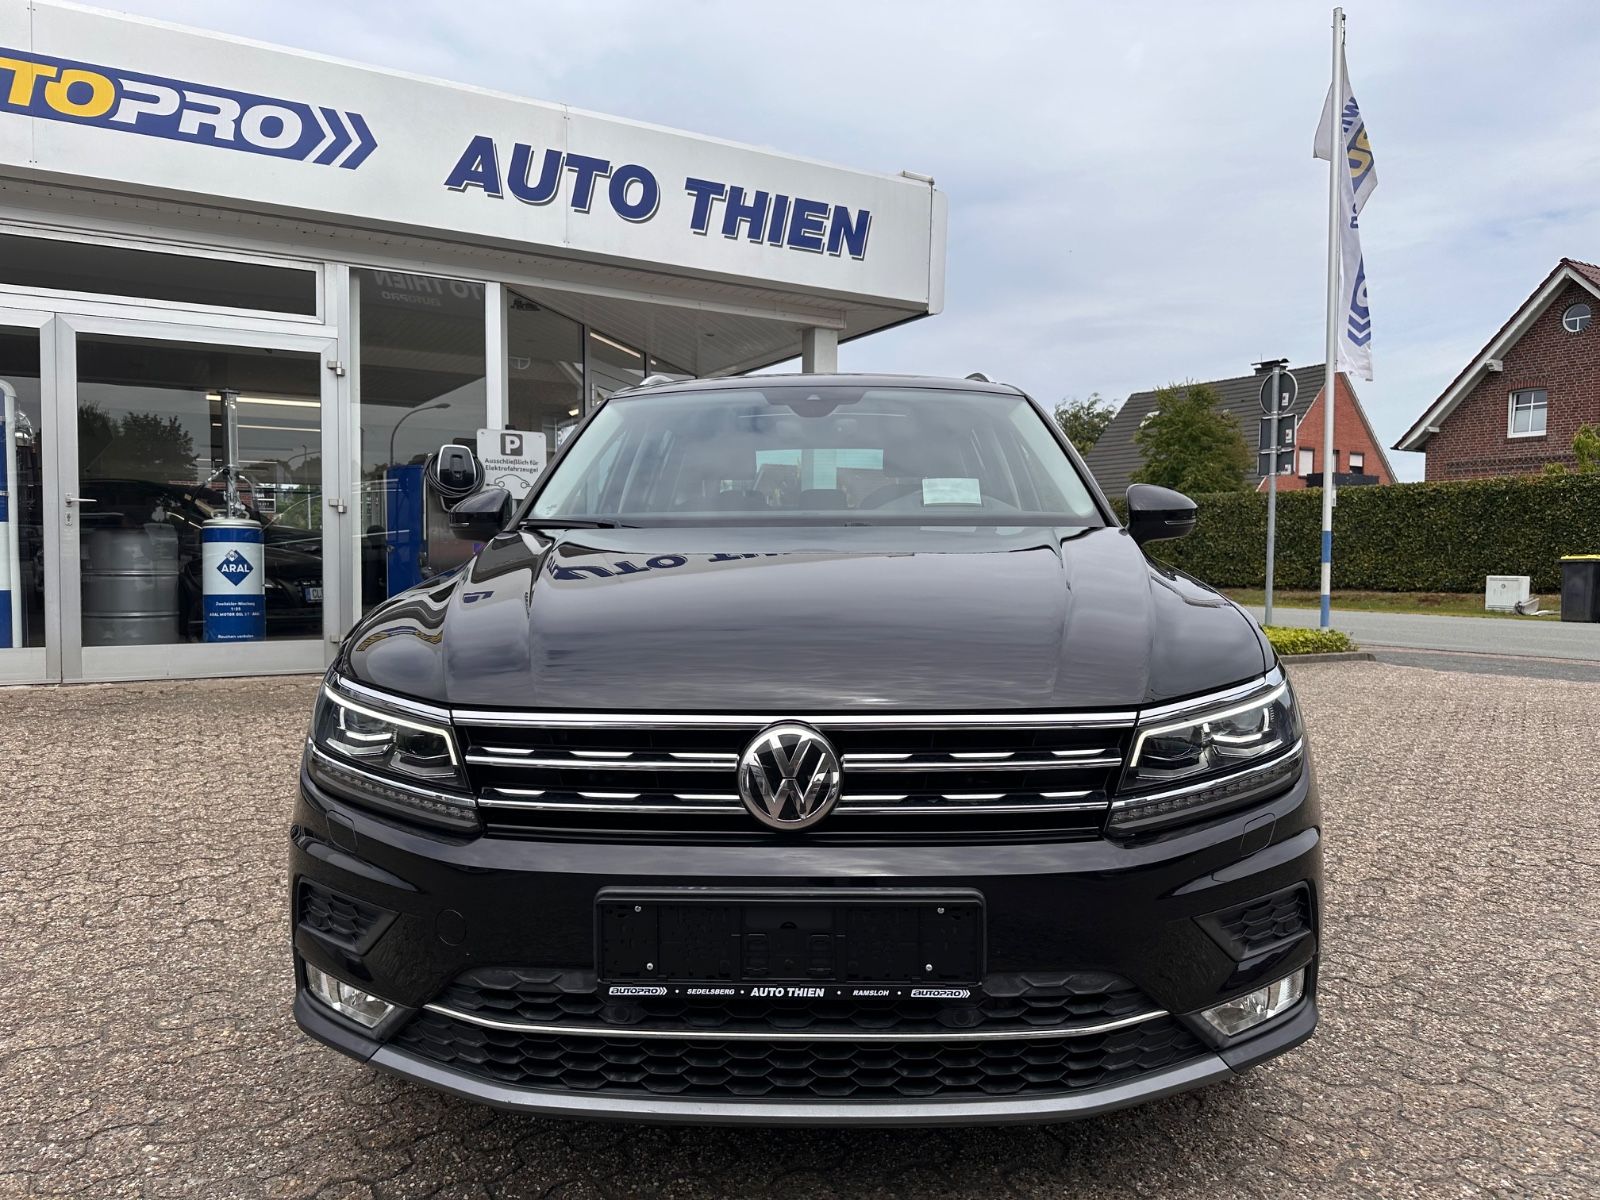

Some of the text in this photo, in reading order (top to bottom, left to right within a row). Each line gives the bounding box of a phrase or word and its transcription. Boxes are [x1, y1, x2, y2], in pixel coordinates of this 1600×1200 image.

[443, 134, 873, 260] AUTO THIEN
[505, 435, 520, 454] P
[221, 563, 250, 573] ARAL
[750, 987, 785, 997] AUTO
[786, 987, 825, 997] THIEN
